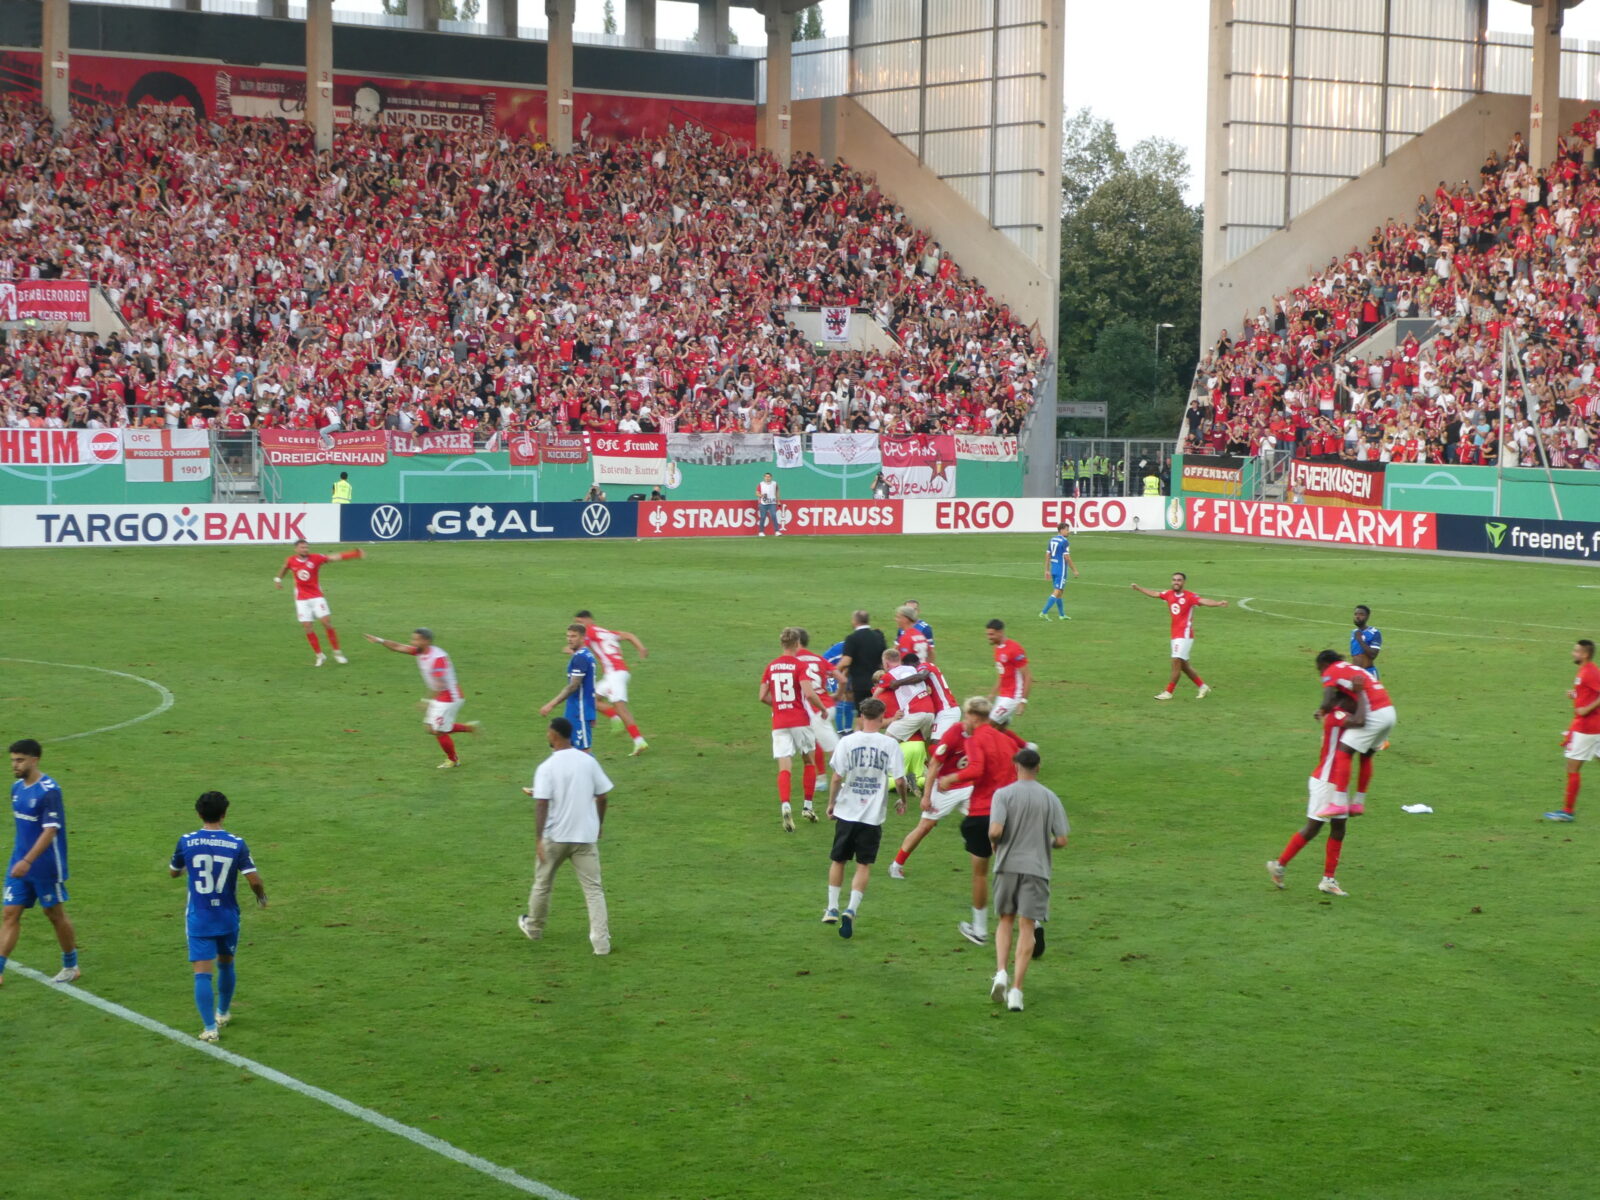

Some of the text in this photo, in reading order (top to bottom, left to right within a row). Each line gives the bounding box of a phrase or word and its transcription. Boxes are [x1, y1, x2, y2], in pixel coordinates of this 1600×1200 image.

[387, 111, 481, 131] NUR DER OFC
[1, 430, 80, 464] HEIM
[132, 434, 151, 442] OFC
[278, 436, 316, 444] KICKERS
[596, 438, 659, 451] OFC Freunde
[883, 440, 907, 457] OFC
[133, 449, 202, 458] PROSECCO-FRONT
[271, 451, 385, 464] DREIEICHENHAIN
[181, 466, 203, 475] 1901
[1291, 461, 1372, 499] LEVERKUSEN
[672, 507, 770, 529] STRAUSS
[796, 506, 894, 527] STRAUSS
[935, 500, 1014, 529] ERGO
[1041, 499, 1127, 529] ERGO
[1213, 499, 1403, 547] FLYERALARM
[36, 512, 307, 543] TARGO BANK
[1511, 526, 1590, 557] freenet,
[771, 672, 797, 703] 13
[192, 853, 234, 895] 37
